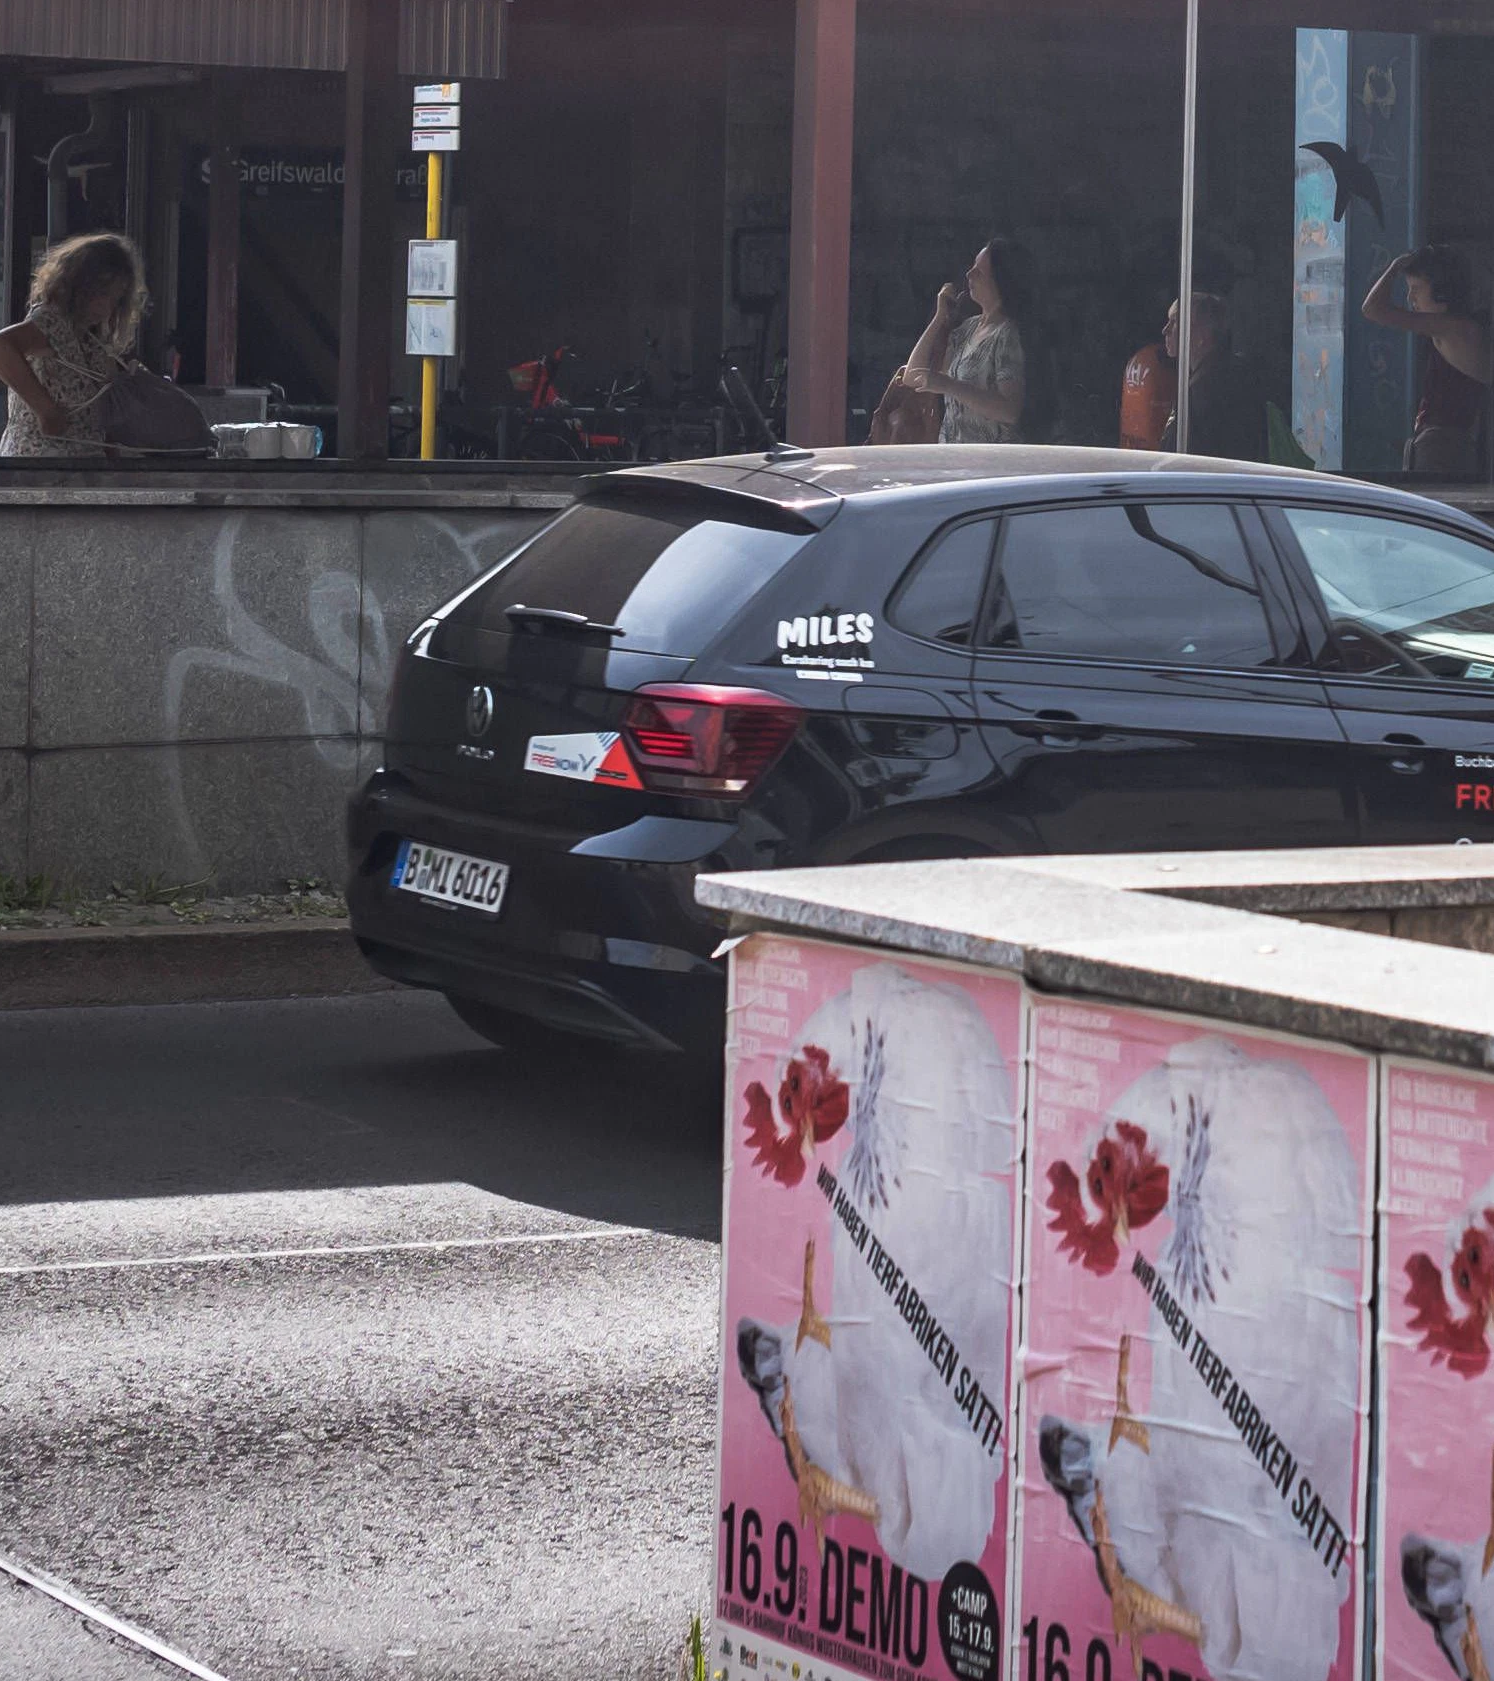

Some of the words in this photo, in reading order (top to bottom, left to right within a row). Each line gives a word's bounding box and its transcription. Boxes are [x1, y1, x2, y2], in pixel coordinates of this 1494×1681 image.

[776, 612, 875, 649] MILES
[404, 846, 422, 886] B
[452, 860, 507, 907] 6016
[833, 1186, 871, 1254] HABEN
[865, 1233, 960, 1388] TIERFABRIKEN
[953, 1365, 1004, 1458] SATT!
[1151, 1275, 1194, 1351] HABEN
[1188, 1328, 1299, 1501] TIERFABRIKEN
[1290, 1477, 1349, 1580] SATT!
[818, 1535, 929, 1668] DEMO
